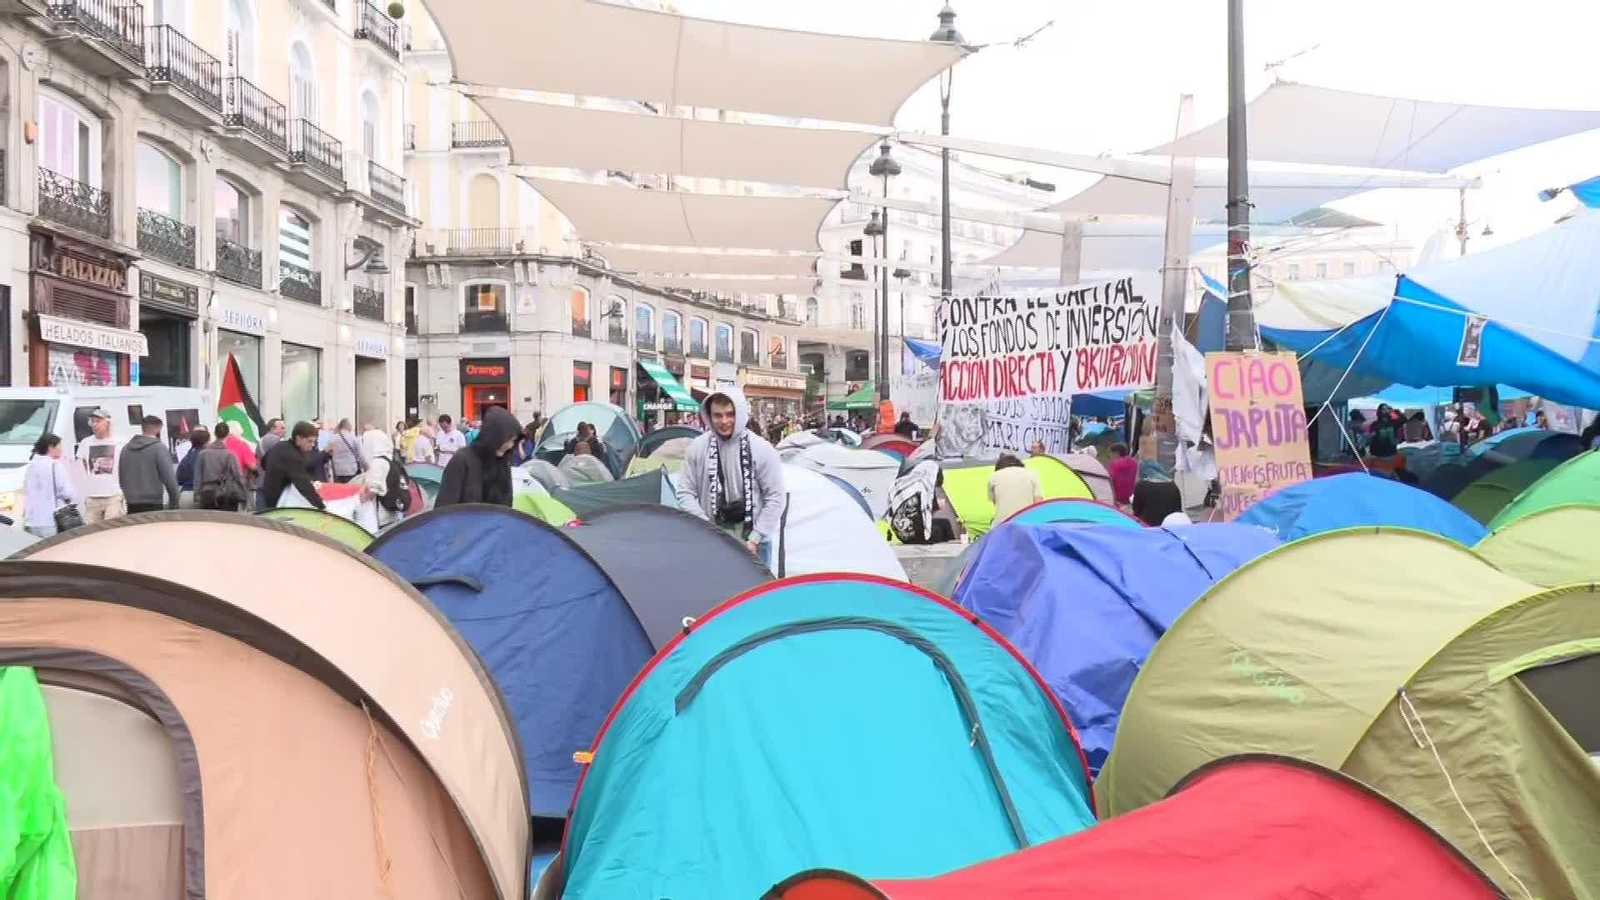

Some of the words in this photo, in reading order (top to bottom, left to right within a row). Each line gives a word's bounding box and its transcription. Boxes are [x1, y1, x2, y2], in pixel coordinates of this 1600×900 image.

[61, 256, 119, 290] PALAZZO
[224, 309, 264, 331] SEPHORA
[941, 297, 1017, 327] CONTRA
[45, 324, 93, 346] HELADOS
[98, 333, 145, 355] ITALIANOS
[951, 327, 979, 357] LOS
[981, 312, 1038, 358] FONDOS
[1047, 310, 1060, 350] DE
[1067, 300, 1158, 349] INVERSIÓN
[466, 364, 505, 377] Orange
[939, 355, 989, 401] ACCIÓN
[1059, 350, 1072, 393] Y
[1076, 337, 1158, 390] OKUPACIÓN
[1213, 358, 1293, 399] CIAO
[643, 402, 673, 411] CHANGE
[1030, 397, 1071, 424] SOMOS
[984, 420, 1020, 451] MARI
[1265, 461, 1308, 483] FRUTA
